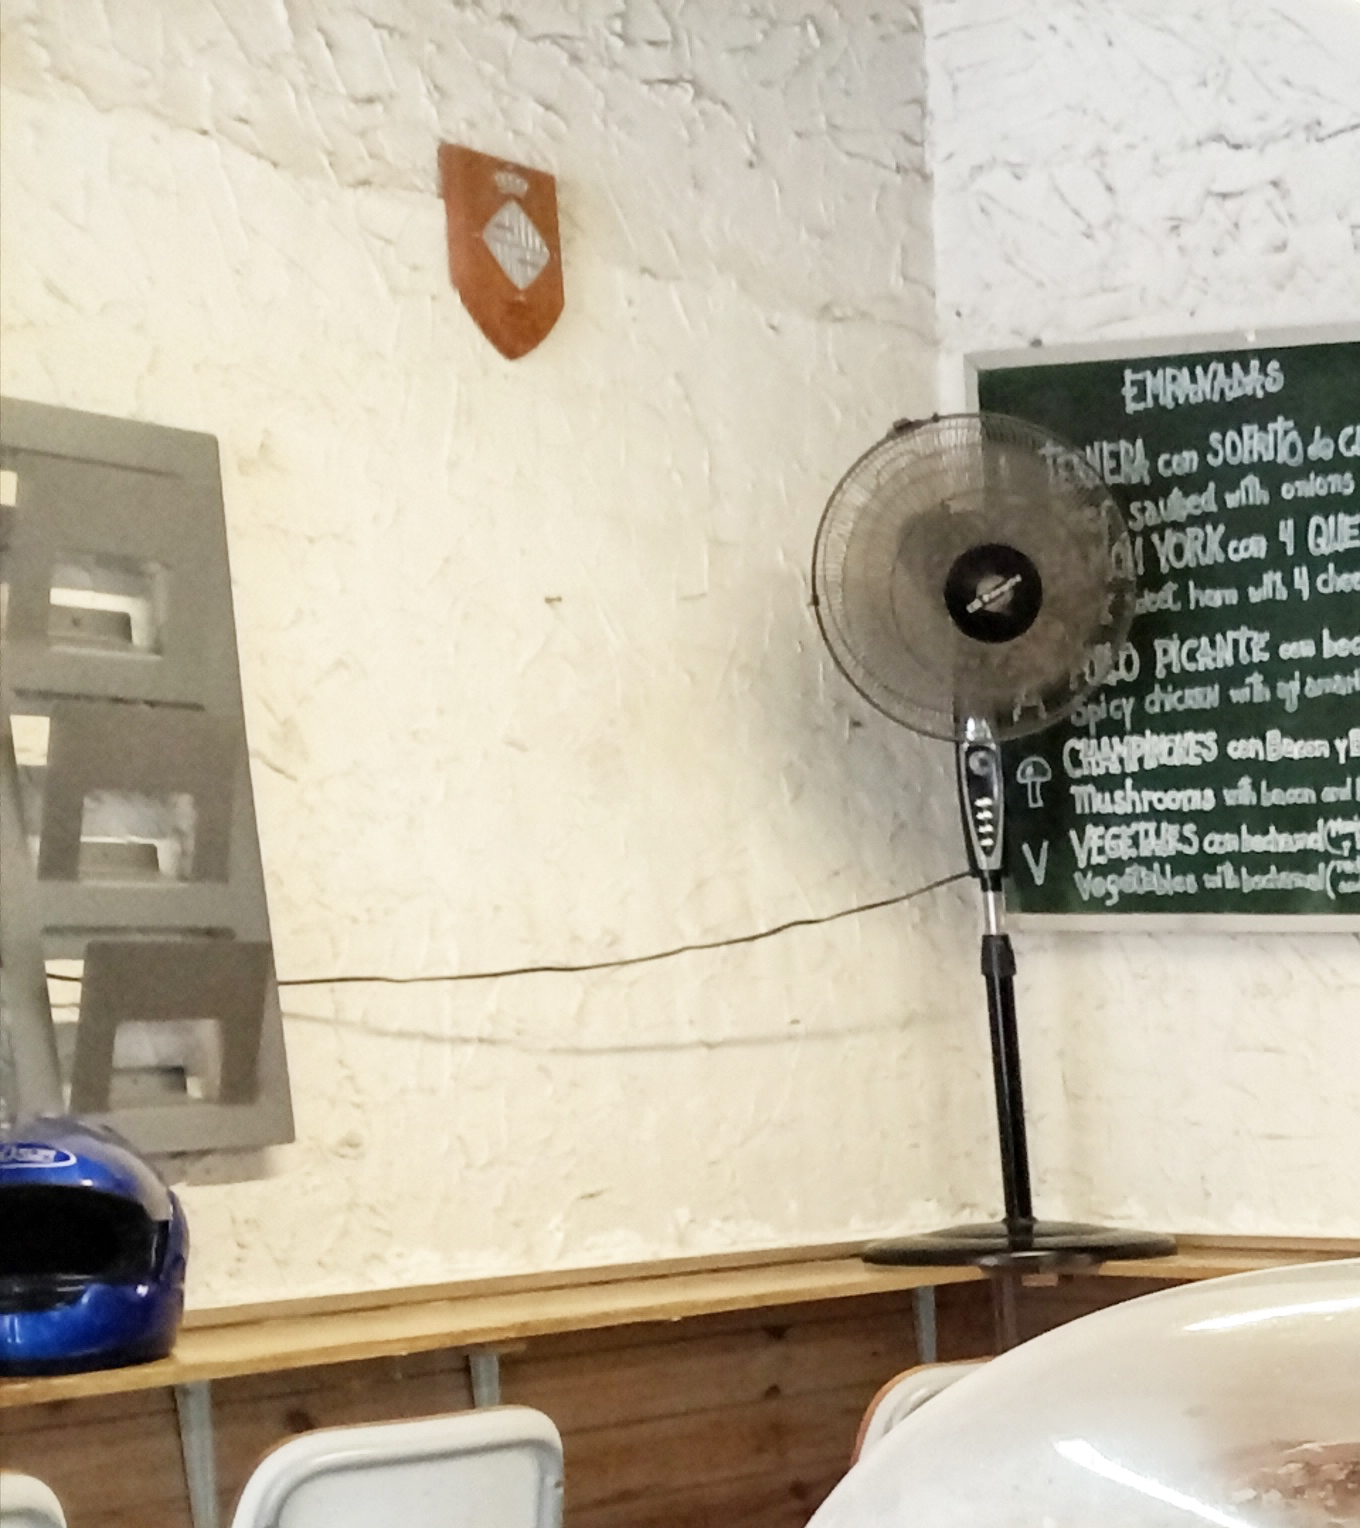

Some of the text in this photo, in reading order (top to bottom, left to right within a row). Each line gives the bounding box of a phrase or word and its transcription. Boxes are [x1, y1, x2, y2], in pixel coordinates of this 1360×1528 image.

[1157, 450, 1198, 477] con
[1151, 523, 1226, 573] YORK
[1228, 534, 1267, 562] con
[1279, 516, 1294, 556] 4
[1293, 564, 1309, 601] 4
[1154, 625, 1269, 678] PICANTE
[1070, 777, 1216, 815] Mushrooms
[1022, 840, 1049, 886] V
